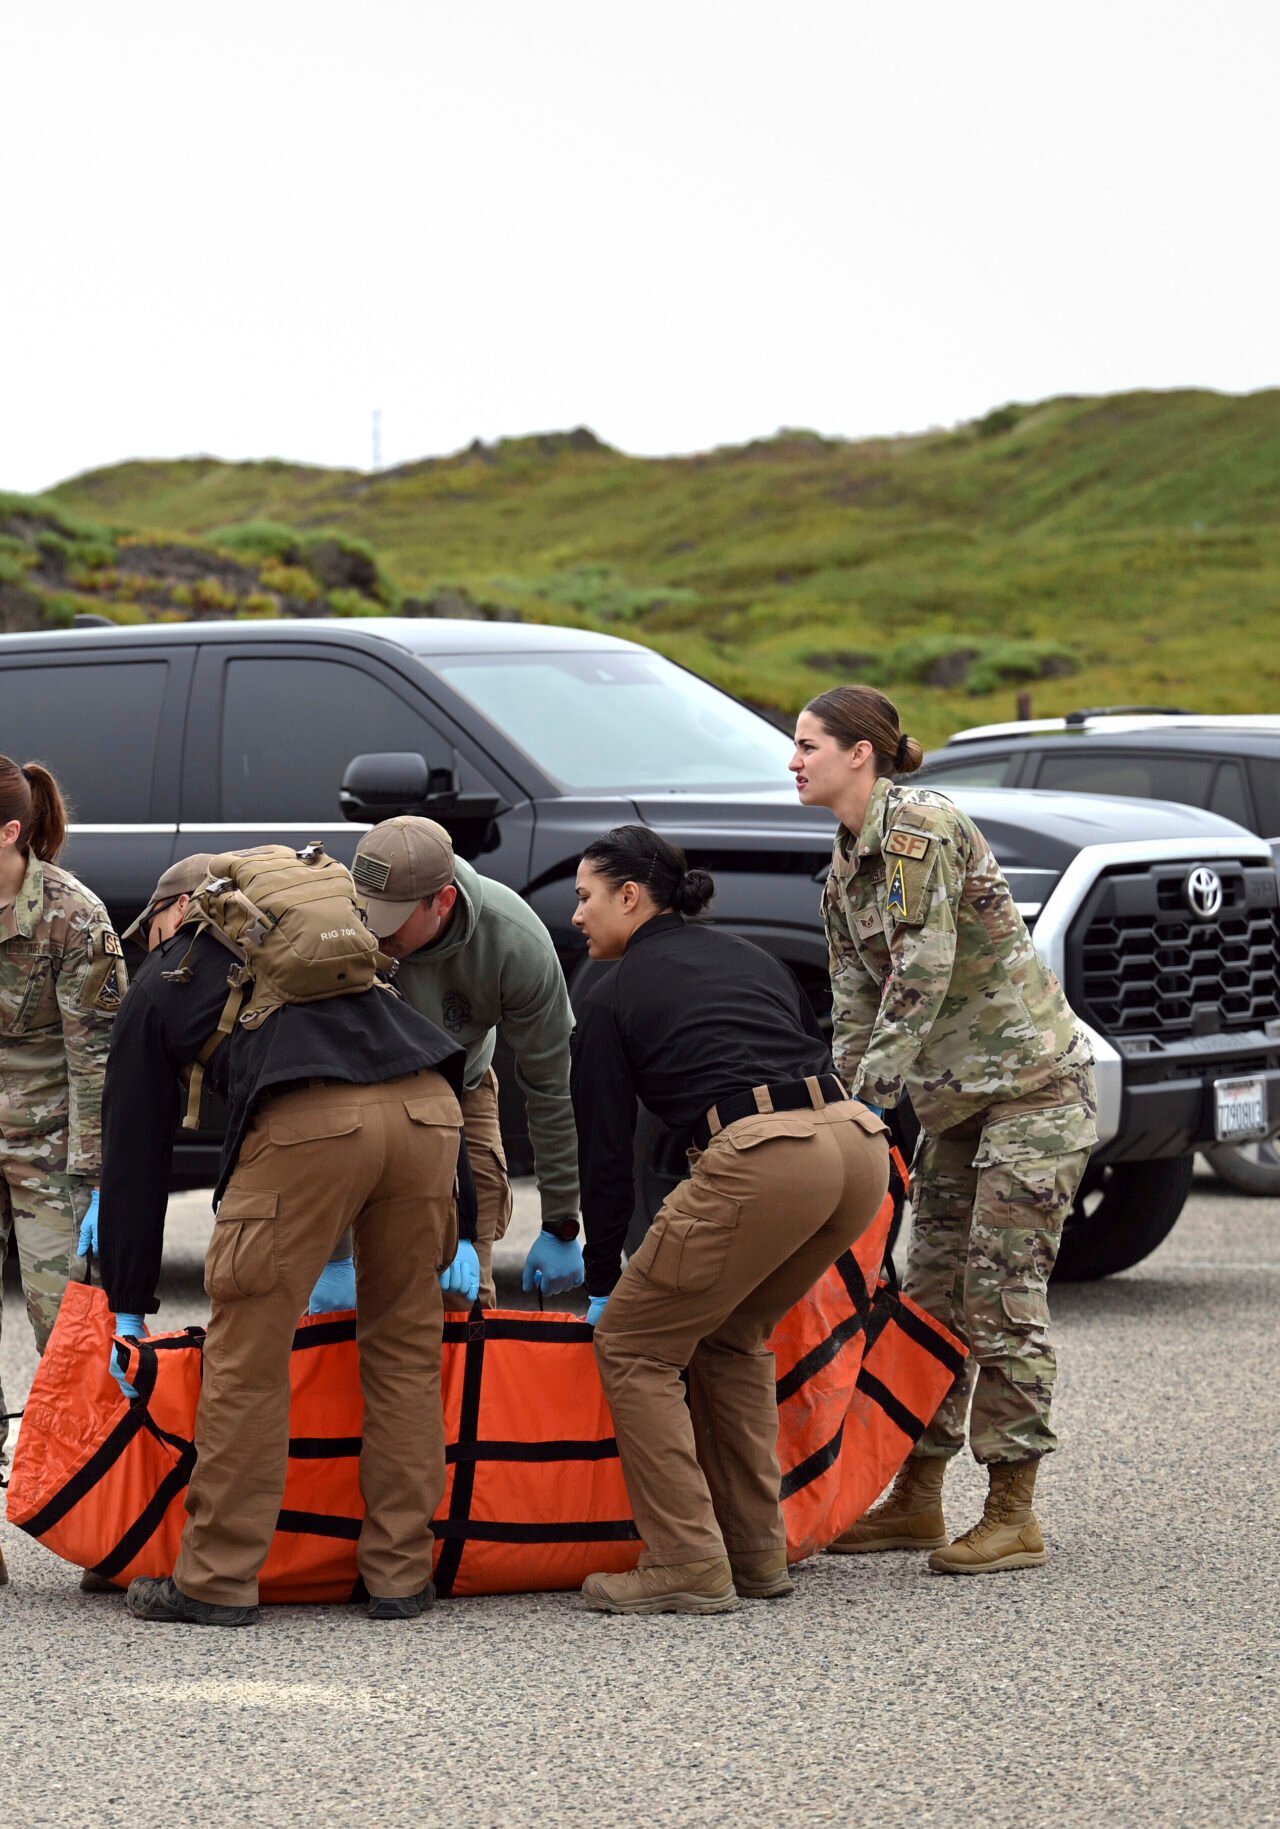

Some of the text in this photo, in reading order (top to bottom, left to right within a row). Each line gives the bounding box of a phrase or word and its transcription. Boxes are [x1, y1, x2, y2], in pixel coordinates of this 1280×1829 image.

[891, 833, 925, 856] SF
[106, 934, 121, 954] SF
[320, 928, 356, 941] RIG 700
